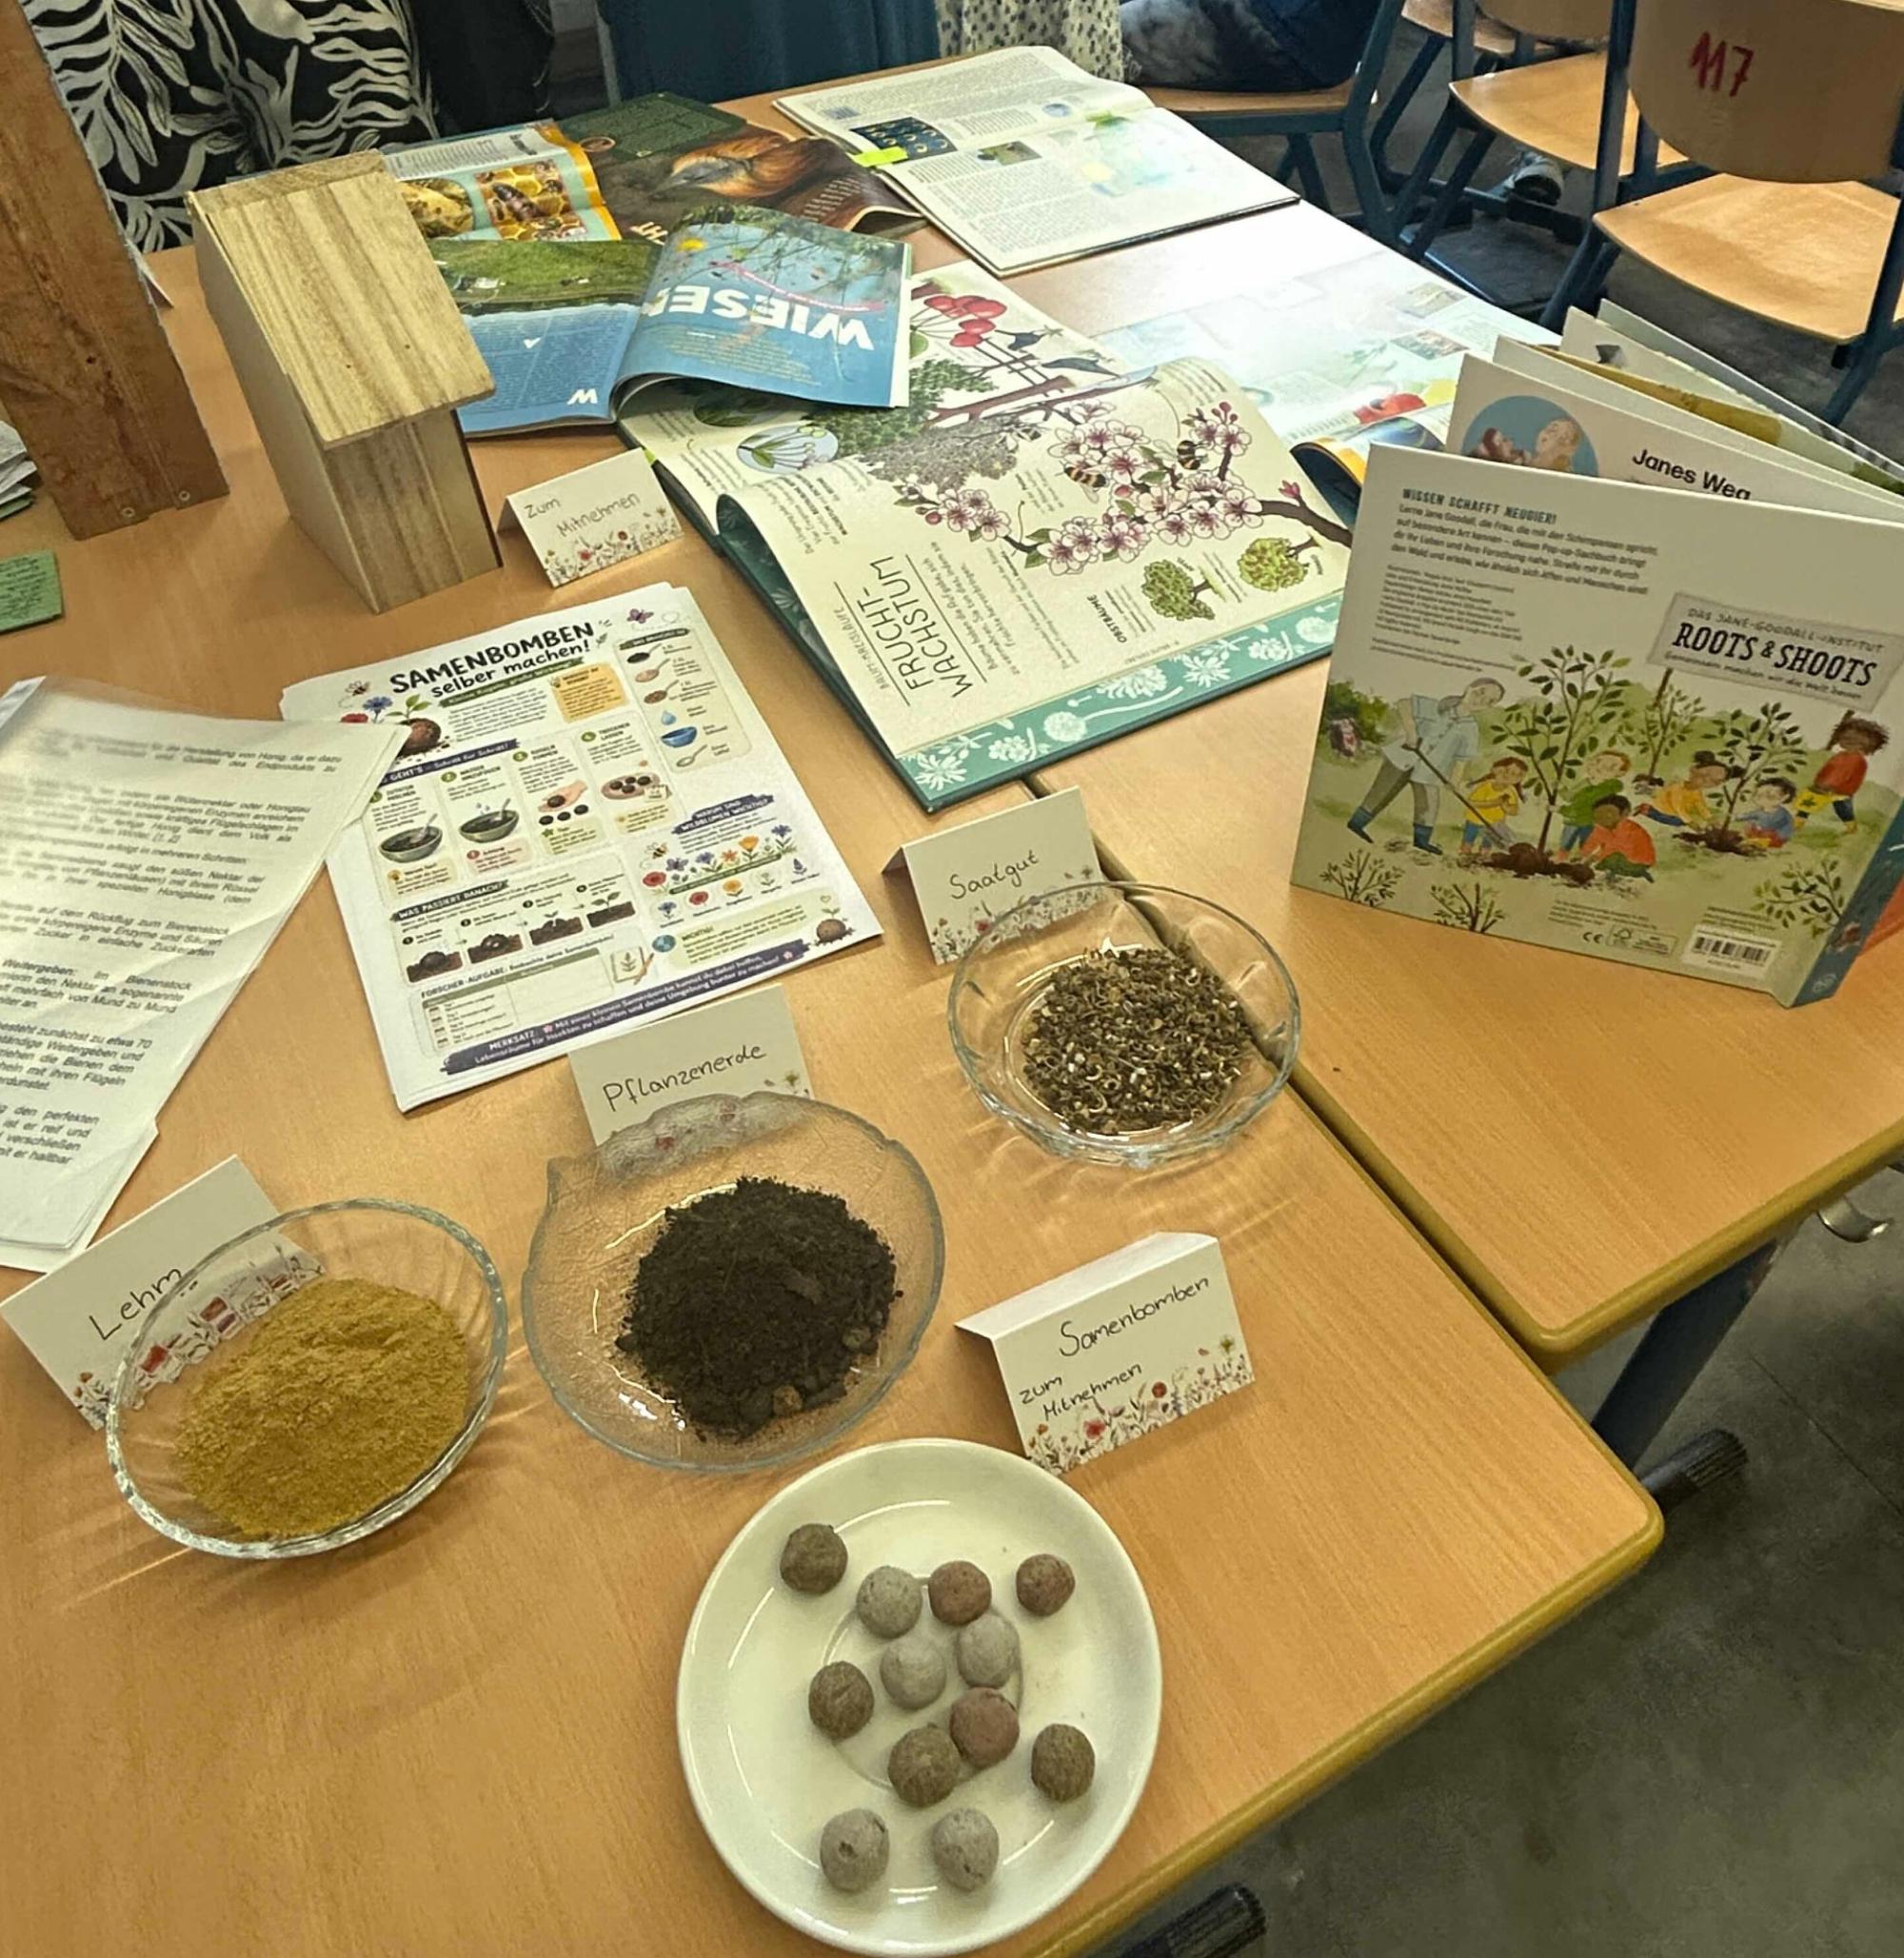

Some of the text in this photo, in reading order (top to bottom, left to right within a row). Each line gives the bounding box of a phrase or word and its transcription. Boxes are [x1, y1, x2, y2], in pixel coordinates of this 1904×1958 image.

[1689, 30, 1755, 97] 117
[1632, 449, 1697, 484] Janes
[556, 492, 641, 538] Mitnehmen
[1399, 504, 1423, 516] Lerne
[1424, 509, 1443, 521] Jane
[1445, 511, 1477, 525] Goodall,
[1478, 519, 1493, 528] die
[1495, 522, 1515, 534] Frau,
[1517, 526, 1531, 535] die
[1532, 528, 1547, 538] mit
[1566, 532, 1624, 549] Schimpansen
[1402, 488, 1557, 524] WISSEN SCHAFFT NEUGIER!
[1394, 530, 1406, 540] dir
[1419, 534, 1445, 546] Leben
[1446, 541, 1462, 550] und
[1463, 543, 1481, 553] ihre
[1482, 545, 1525, 564] Forschung
[1583, 564, 1599, 572] mit
[1601, 564, 1612, 575] ihr
[1614, 567, 1639, 580] durch
[1397, 517, 1647, 568] auf besondere Art kennen Pop-up-Sachbuch bringt
[1391, 544, 1406, 552] den
[1408, 545, 1428, 557] Wald
[1429, 551, 1444, 561] und
[1476, 561, 1490, 569] wie
[1521, 568, 1539, 577] sich
[1541, 569, 1563, 582] Affen
[1565, 574, 1580, 583] und
[1582, 577, 1625, 591] Menschen
[857, 586, 935, 690] FRUCHT-
[869, 556, 973, 698] WACHSTUM
[1688, 608, 1886, 654] DAS JANE-GOODALL-INSTITUT
[389, 622, 595, 695] SAMENBOMBEN
[430, 639, 591, 698] selber machen!
[1672, 622, 1877, 686] ROOTS & SHOOTS
[389, 765, 424, 781] GEHT'S
[949, 849, 1040, 900] Saatgut
[399, 905, 420, 920] WAS
[422, 893, 462, 913] PASSIERT
[90, 995, 125, 1007] Mund
[145, 1001, 177, 1014] Mund
[125, 976, 191, 990] Bienenstock
[532, 1037, 545, 1047] für
[594, 1011, 627, 1026] schaffen
[667, 982, 709, 999] Umgebung
[47, 1041, 118, 1058] Weitergeben
[121, 1052, 145, 1061] und
[63, 1056, 104, 1070] Bienen
[137, 1038, 153, 1048] 70
[83, 1072, 126, 1087] Flügeln
[602, 1044, 767, 1113] Pflanzenerde
[13, 1106, 100, 1125] den perfekten
[41, 1124, 64, 1135] reif
[67, 1128, 92, 1138] und
[6, 1135, 82, 1151] verschließen
[29, 1151, 73, 1164] haltbar
[89, 1267, 183, 1341] Lehm
[1059, 1276, 1210, 1357] Samenbomben
[1019, 1375, 1063, 1405] zum
[1042, 1361, 1142, 1421] Mitnehmen
